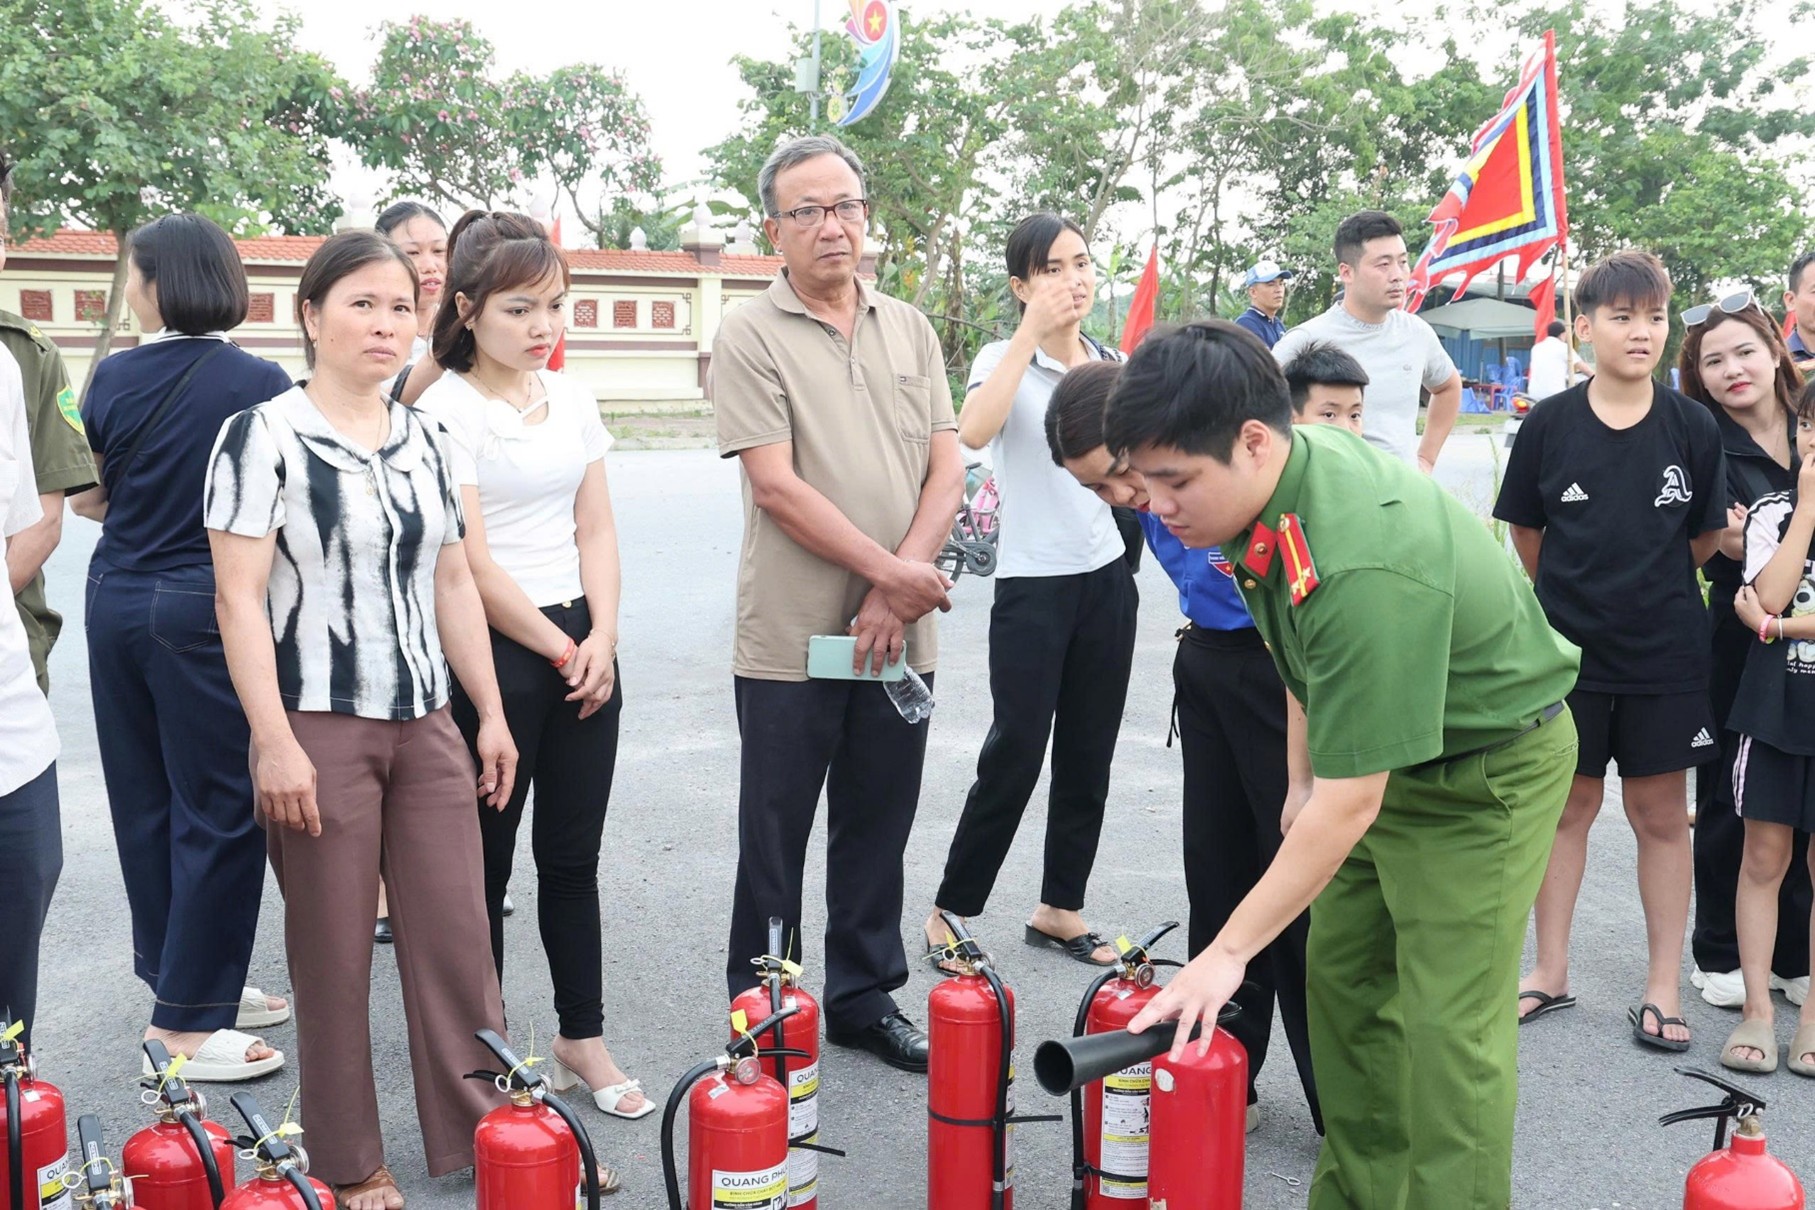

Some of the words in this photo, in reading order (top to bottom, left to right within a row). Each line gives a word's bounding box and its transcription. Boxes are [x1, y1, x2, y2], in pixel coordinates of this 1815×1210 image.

[1561, 493, 1589, 503] adidas
[1691, 738, 1714, 749] adidas
[1120, 1066, 1152, 1075] UANG
[721, 1175, 769, 1187] QUANG
